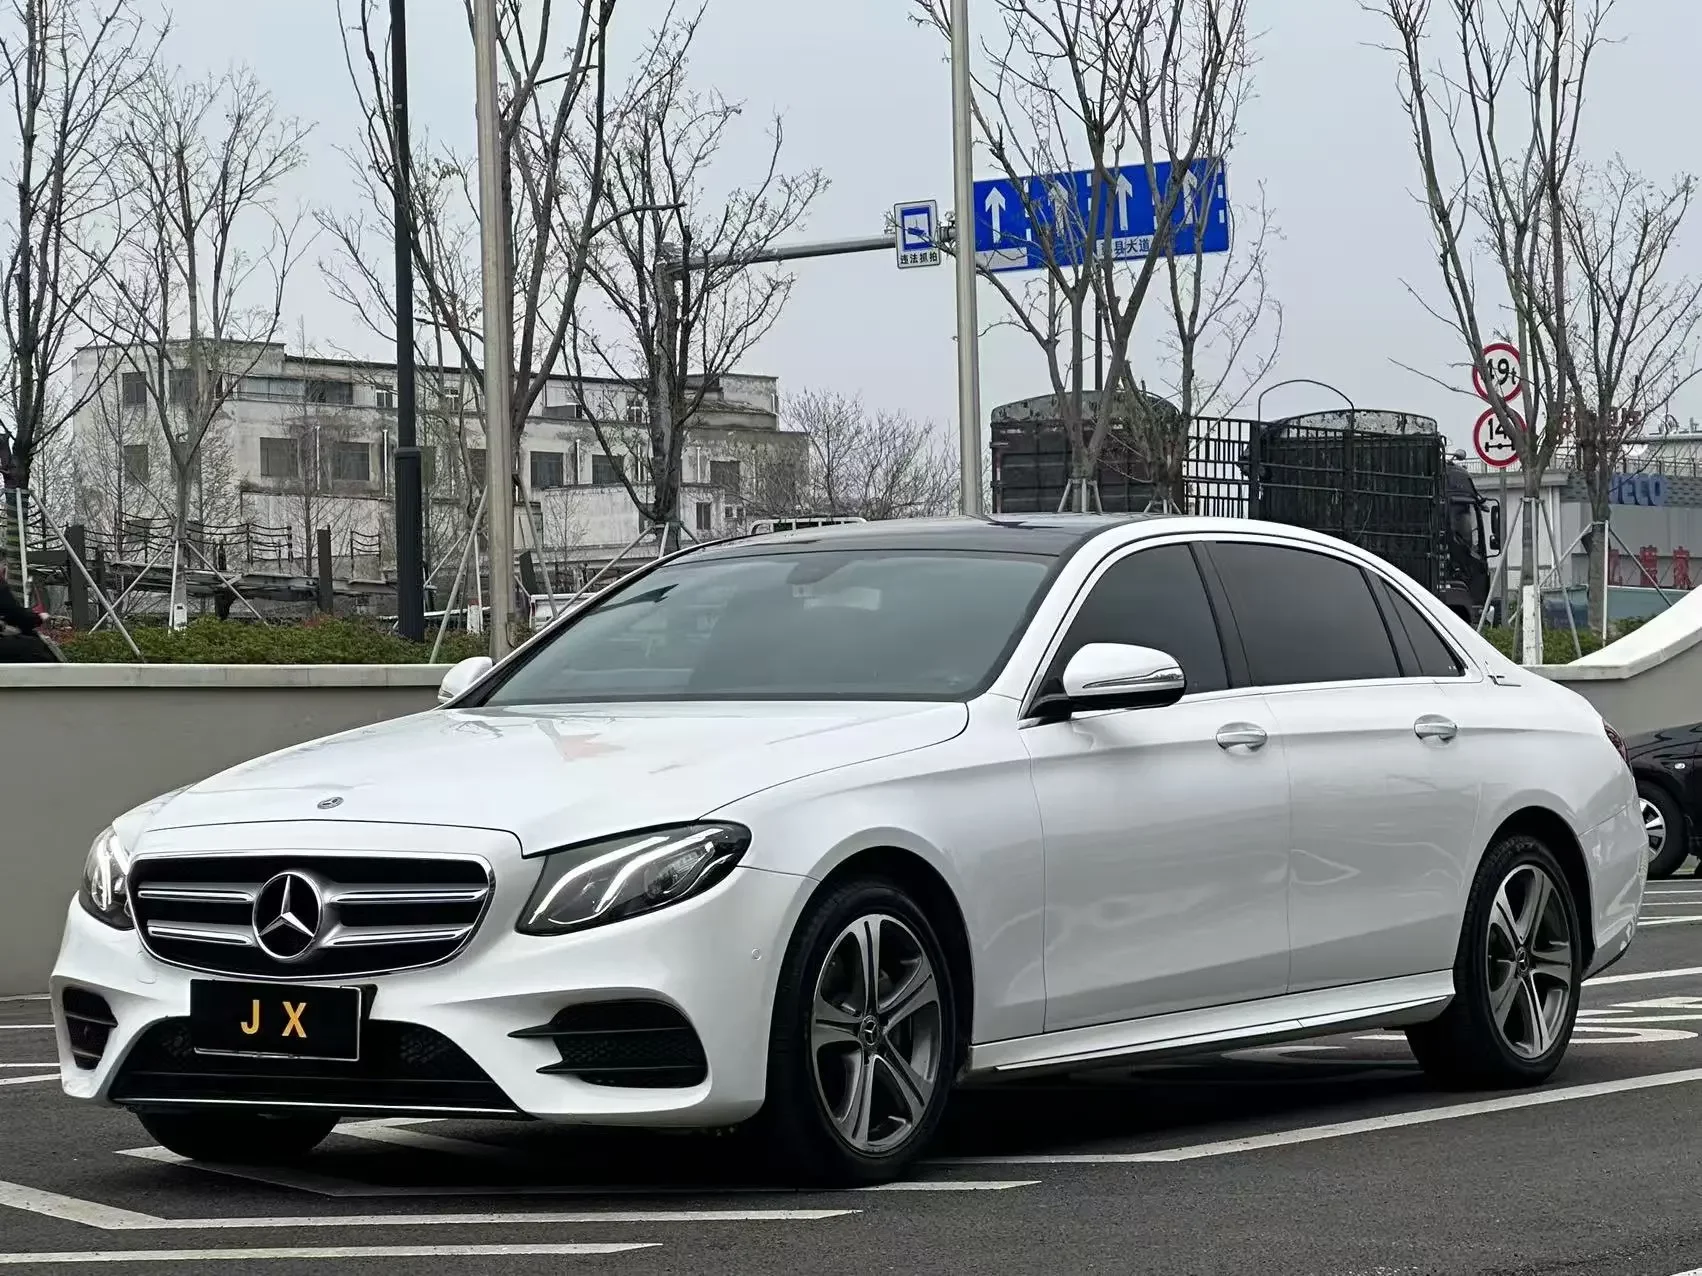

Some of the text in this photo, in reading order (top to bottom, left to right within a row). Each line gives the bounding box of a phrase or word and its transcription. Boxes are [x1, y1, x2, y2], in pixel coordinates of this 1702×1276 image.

[1101, 238, 1150, 255] 县大道
[900, 251, 938, 265] 违法抓拍
